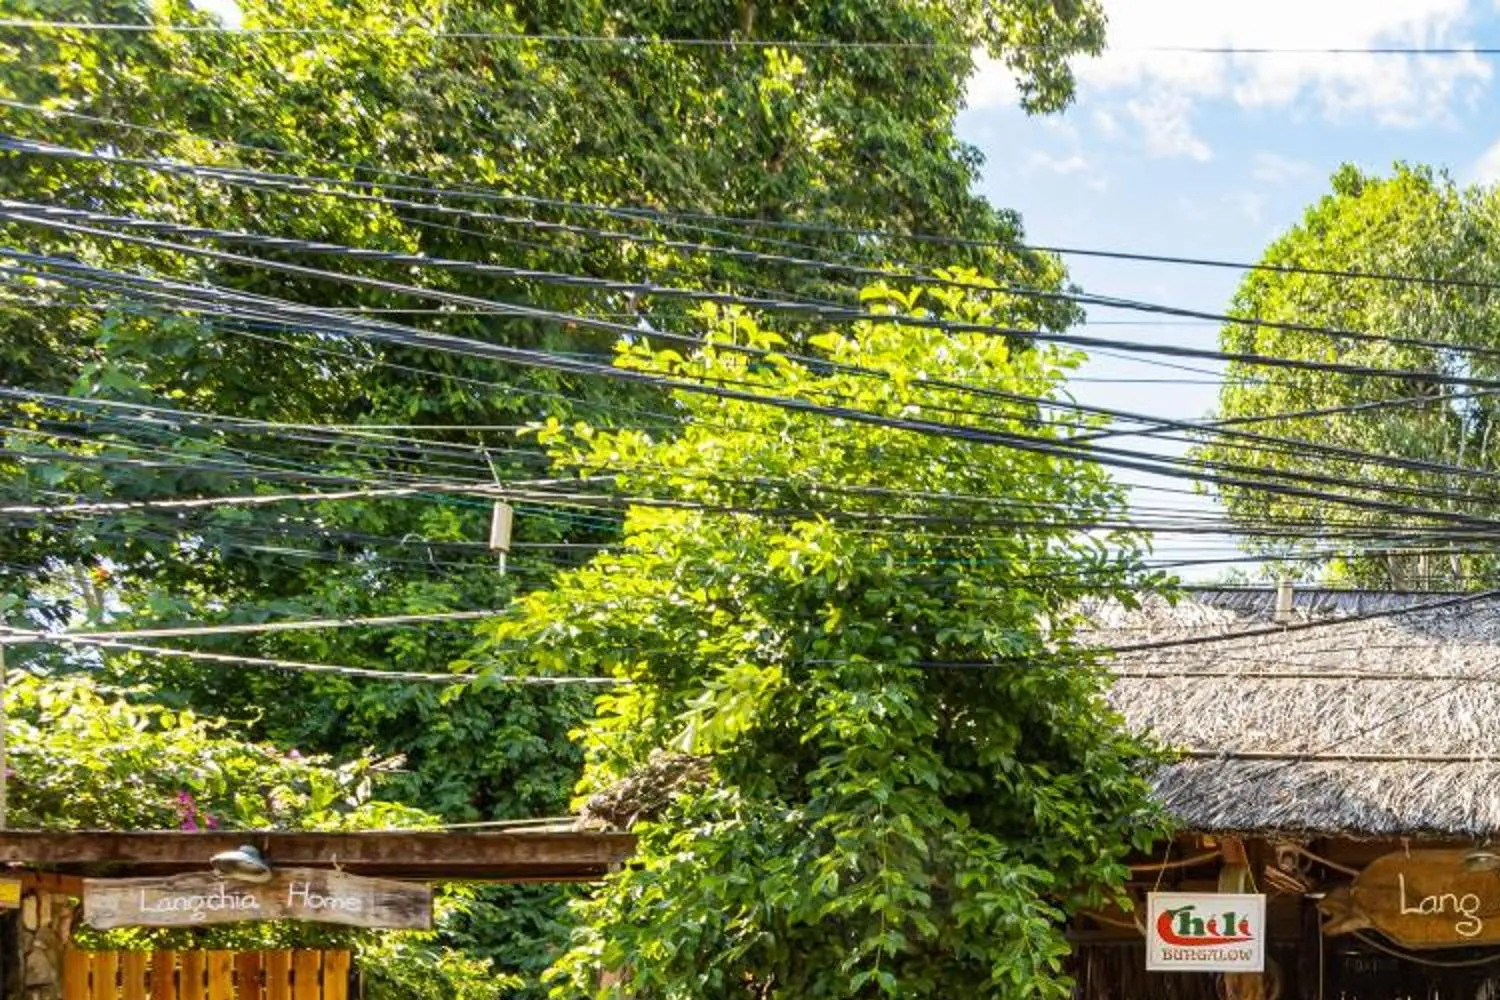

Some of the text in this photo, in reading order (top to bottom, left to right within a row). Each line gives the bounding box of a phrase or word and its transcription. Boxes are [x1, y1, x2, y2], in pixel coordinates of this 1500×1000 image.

[288, 882, 361, 912] Home
[1398, 872, 1483, 937] Lang
[1157, 905, 1256, 946] Chili
[1162, 947, 1253, 961] BUNGALOW
